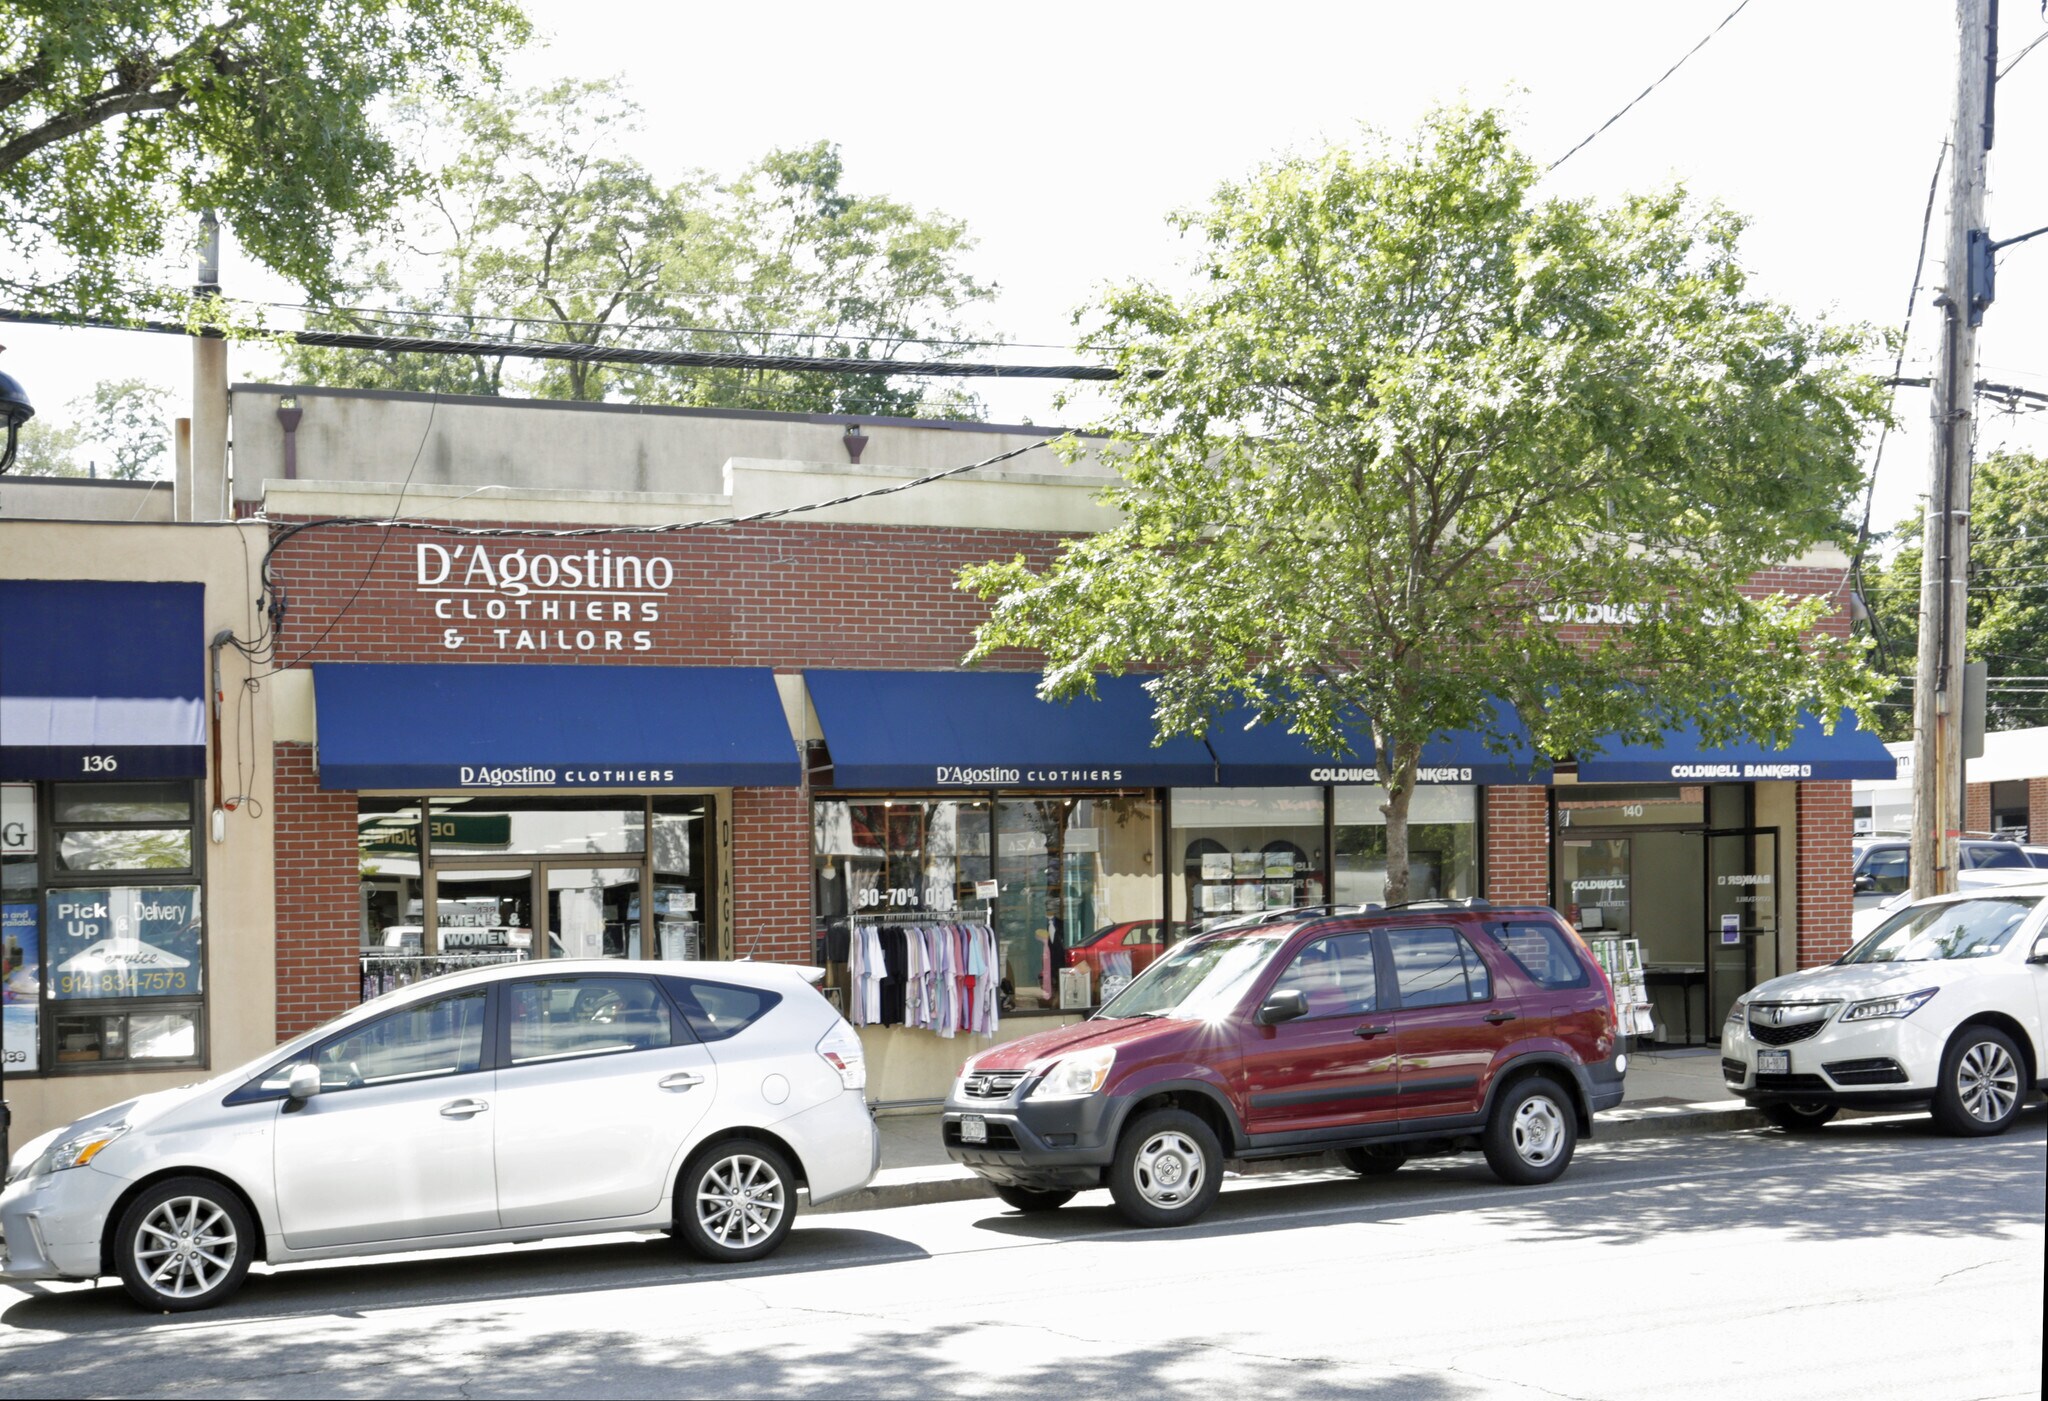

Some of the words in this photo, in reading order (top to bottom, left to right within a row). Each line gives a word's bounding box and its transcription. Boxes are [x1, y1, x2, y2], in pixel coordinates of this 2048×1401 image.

[416, 543, 674, 596] D'Agostino
[434, 598, 659, 622] CLOTHIERS
[443, 628, 464, 649] &
[493, 629, 652, 651] TAILORS
[82, 755, 117, 772] 136
[1671, 764, 1741, 778] COLDWELL
[1744, 765, 1800, 779] BANKER
[564, 770, 674, 782] CLOTHIERS
[936, 766, 1020, 785] D'Agostino
[1027, 770, 1123, 781] CLOTHIERS
[1310, 768, 1380, 782] COLDWEL
[1622, 805, 1643, 817] 140
[722, 820, 730, 960] D'AGO
[1571, 880, 1626, 890] COLDWELL
[859, 888, 919, 907] 30-70%
[58, 902, 108, 919] Pick
[134, 901, 187, 925] Delivery
[451, 914, 501, 926] MEN'S
[509, 913, 520, 925] &
[68, 921, 99, 940] Up
